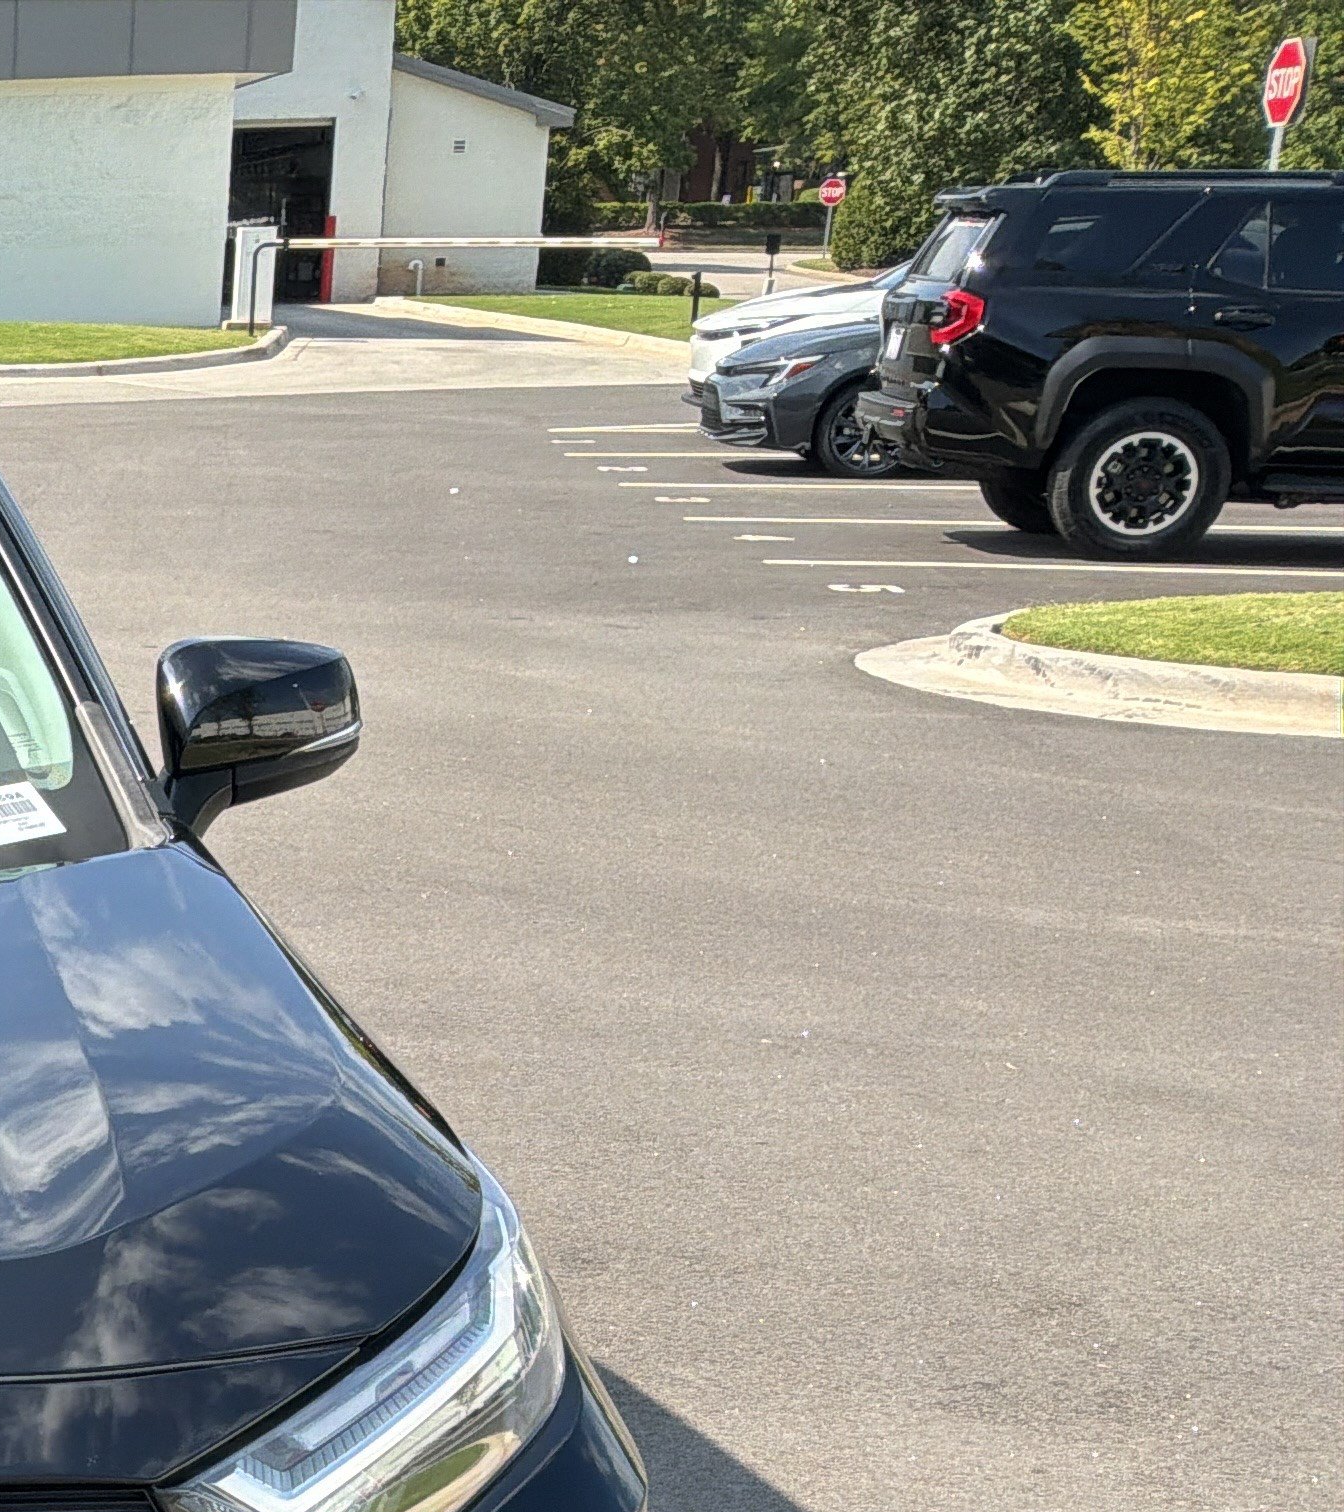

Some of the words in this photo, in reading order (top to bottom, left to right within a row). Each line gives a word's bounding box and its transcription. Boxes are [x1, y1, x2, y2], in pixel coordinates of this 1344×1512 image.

[1267, 66, 1302, 100] STOP
[821, 187, 845, 198] STOP
[827, 583, 906, 593] 5
